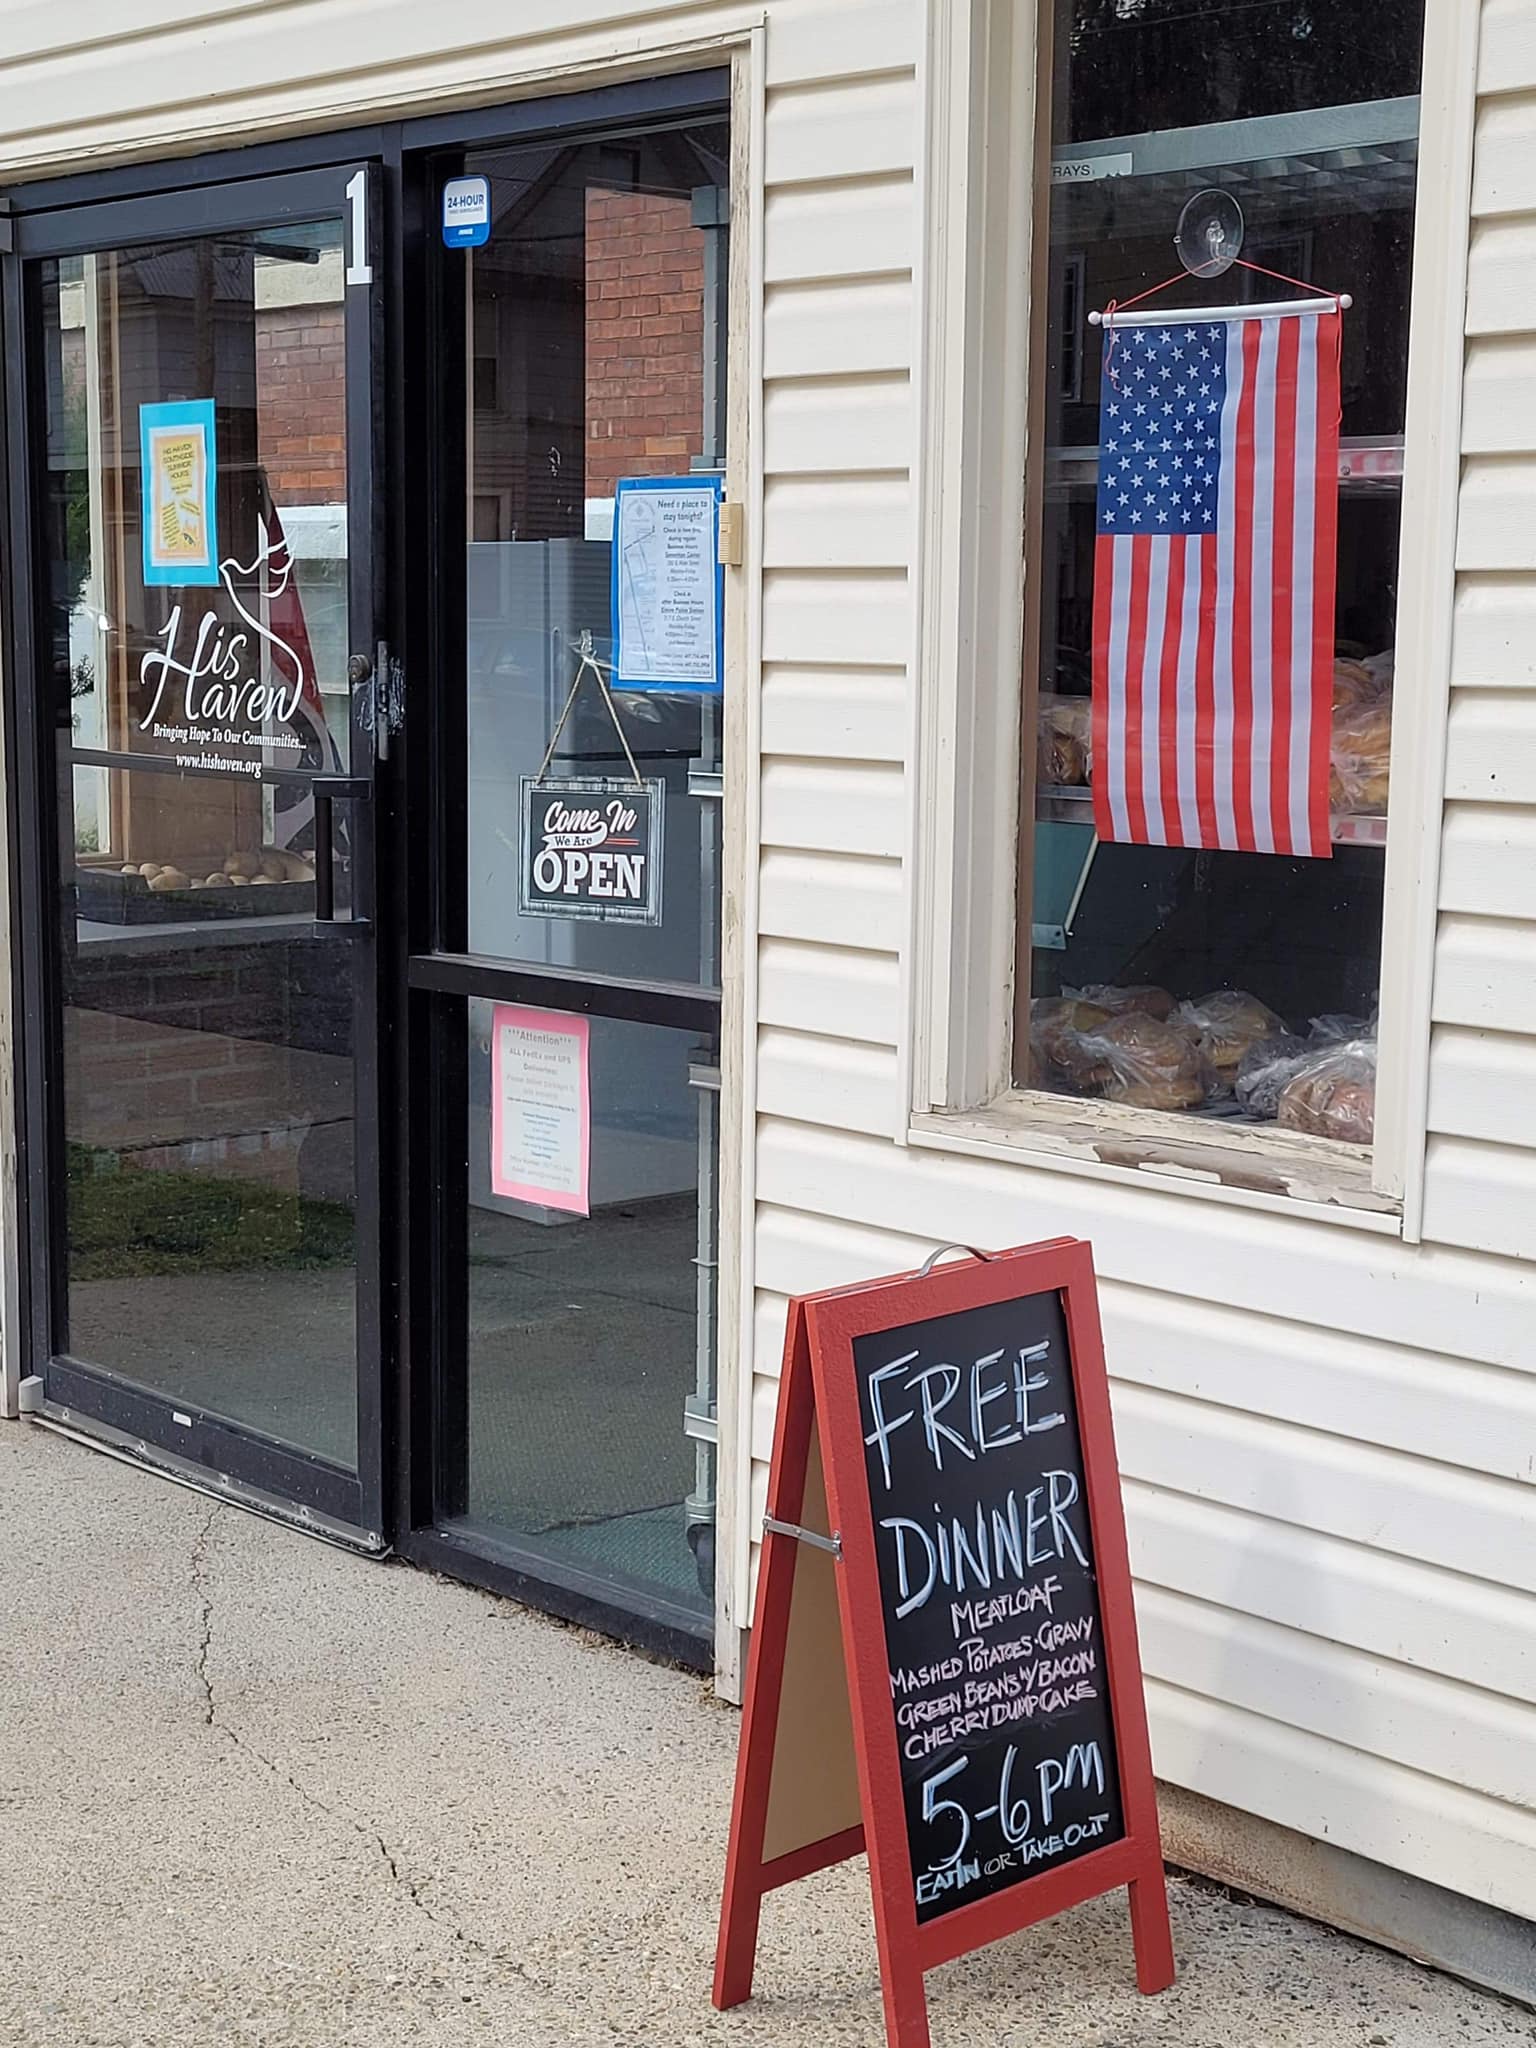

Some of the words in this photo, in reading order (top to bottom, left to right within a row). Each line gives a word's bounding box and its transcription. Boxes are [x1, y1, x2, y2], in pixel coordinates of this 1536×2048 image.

[1051, 164, 1091, 177] RAYS
[447, 193, 485, 209] 24-HOUR
[346, 170, 373, 285] 1
[657, 499, 675, 508] Need
[681, 499, 699, 511] place
[140, 605, 248, 685] His
[139, 652, 304, 731] Haven
[153, 722, 189, 744] Bringing
[189, 725, 212, 746] Hope
[212, 728, 222, 743] To
[224, 728, 242, 744] Our
[176, 751, 262, 779] www.hishaven.org
[544, 800, 600, 834] Come
[606, 799, 638, 834] In
[554, 836, 571, 847] We
[573, 836, 593, 847] Are
[533, 849, 645, 899] OPEN
[864, 1340, 1066, 1490] FREE
[950, 1575, 1063, 1638] MEATLOAF
[889, 1658, 964, 1699] MASHED
[896, 1691, 962, 1731] GREEN
[963, 1671, 1022, 1709] BEANS
[903, 1706, 990, 1761] CHERRY
[983, 1852, 1018, 1876] OR
